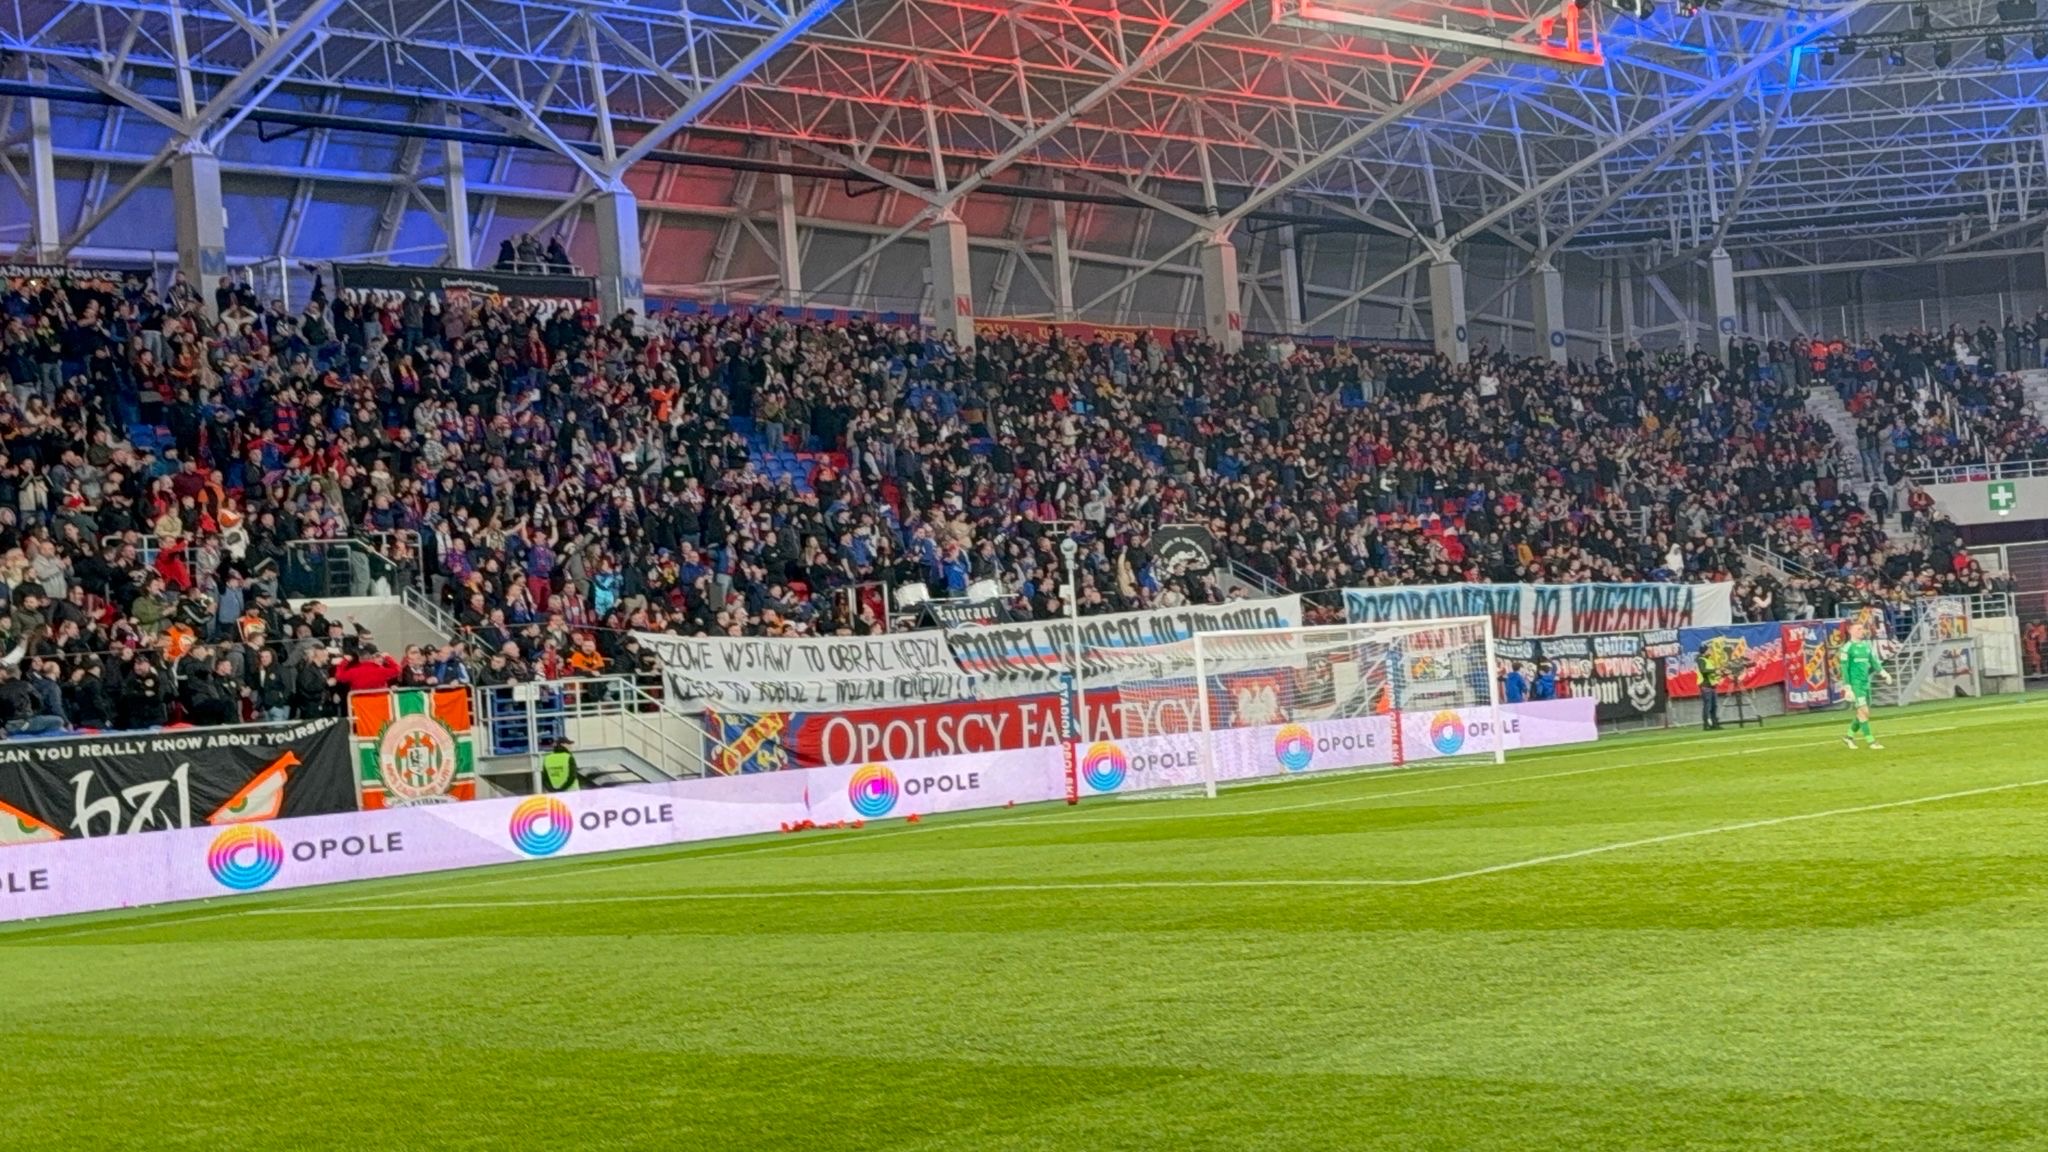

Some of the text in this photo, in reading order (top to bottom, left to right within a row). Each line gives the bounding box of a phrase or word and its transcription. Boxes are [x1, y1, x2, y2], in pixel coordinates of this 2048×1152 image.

[201, 249, 226, 275] M
[624, 278, 641, 298] M
[957, 296, 971, 316] N
[1228, 312, 1240, 331] N
[719, 642, 793, 672] WYSTAWY
[798, 644, 825, 672] TO
[828, 641, 894, 673] OBRAZ
[1060, 681, 1071, 738] STADION
[36, 746, 73, 761] YOU
[79, 741, 147, 758] REALLY
[152, 736, 203, 752] KNOW
[206, 734, 262, 748] ABOUT
[822, 713, 1009, 767] OPOLSCY
[1317, 733, 1376, 753] OPOLE
[1131, 750, 1198, 772] OPOLE
[903, 772, 981, 797] OPOLE
[580, 804, 674, 831] OPOLE
[292, 832, 404, 863] OPOLE
